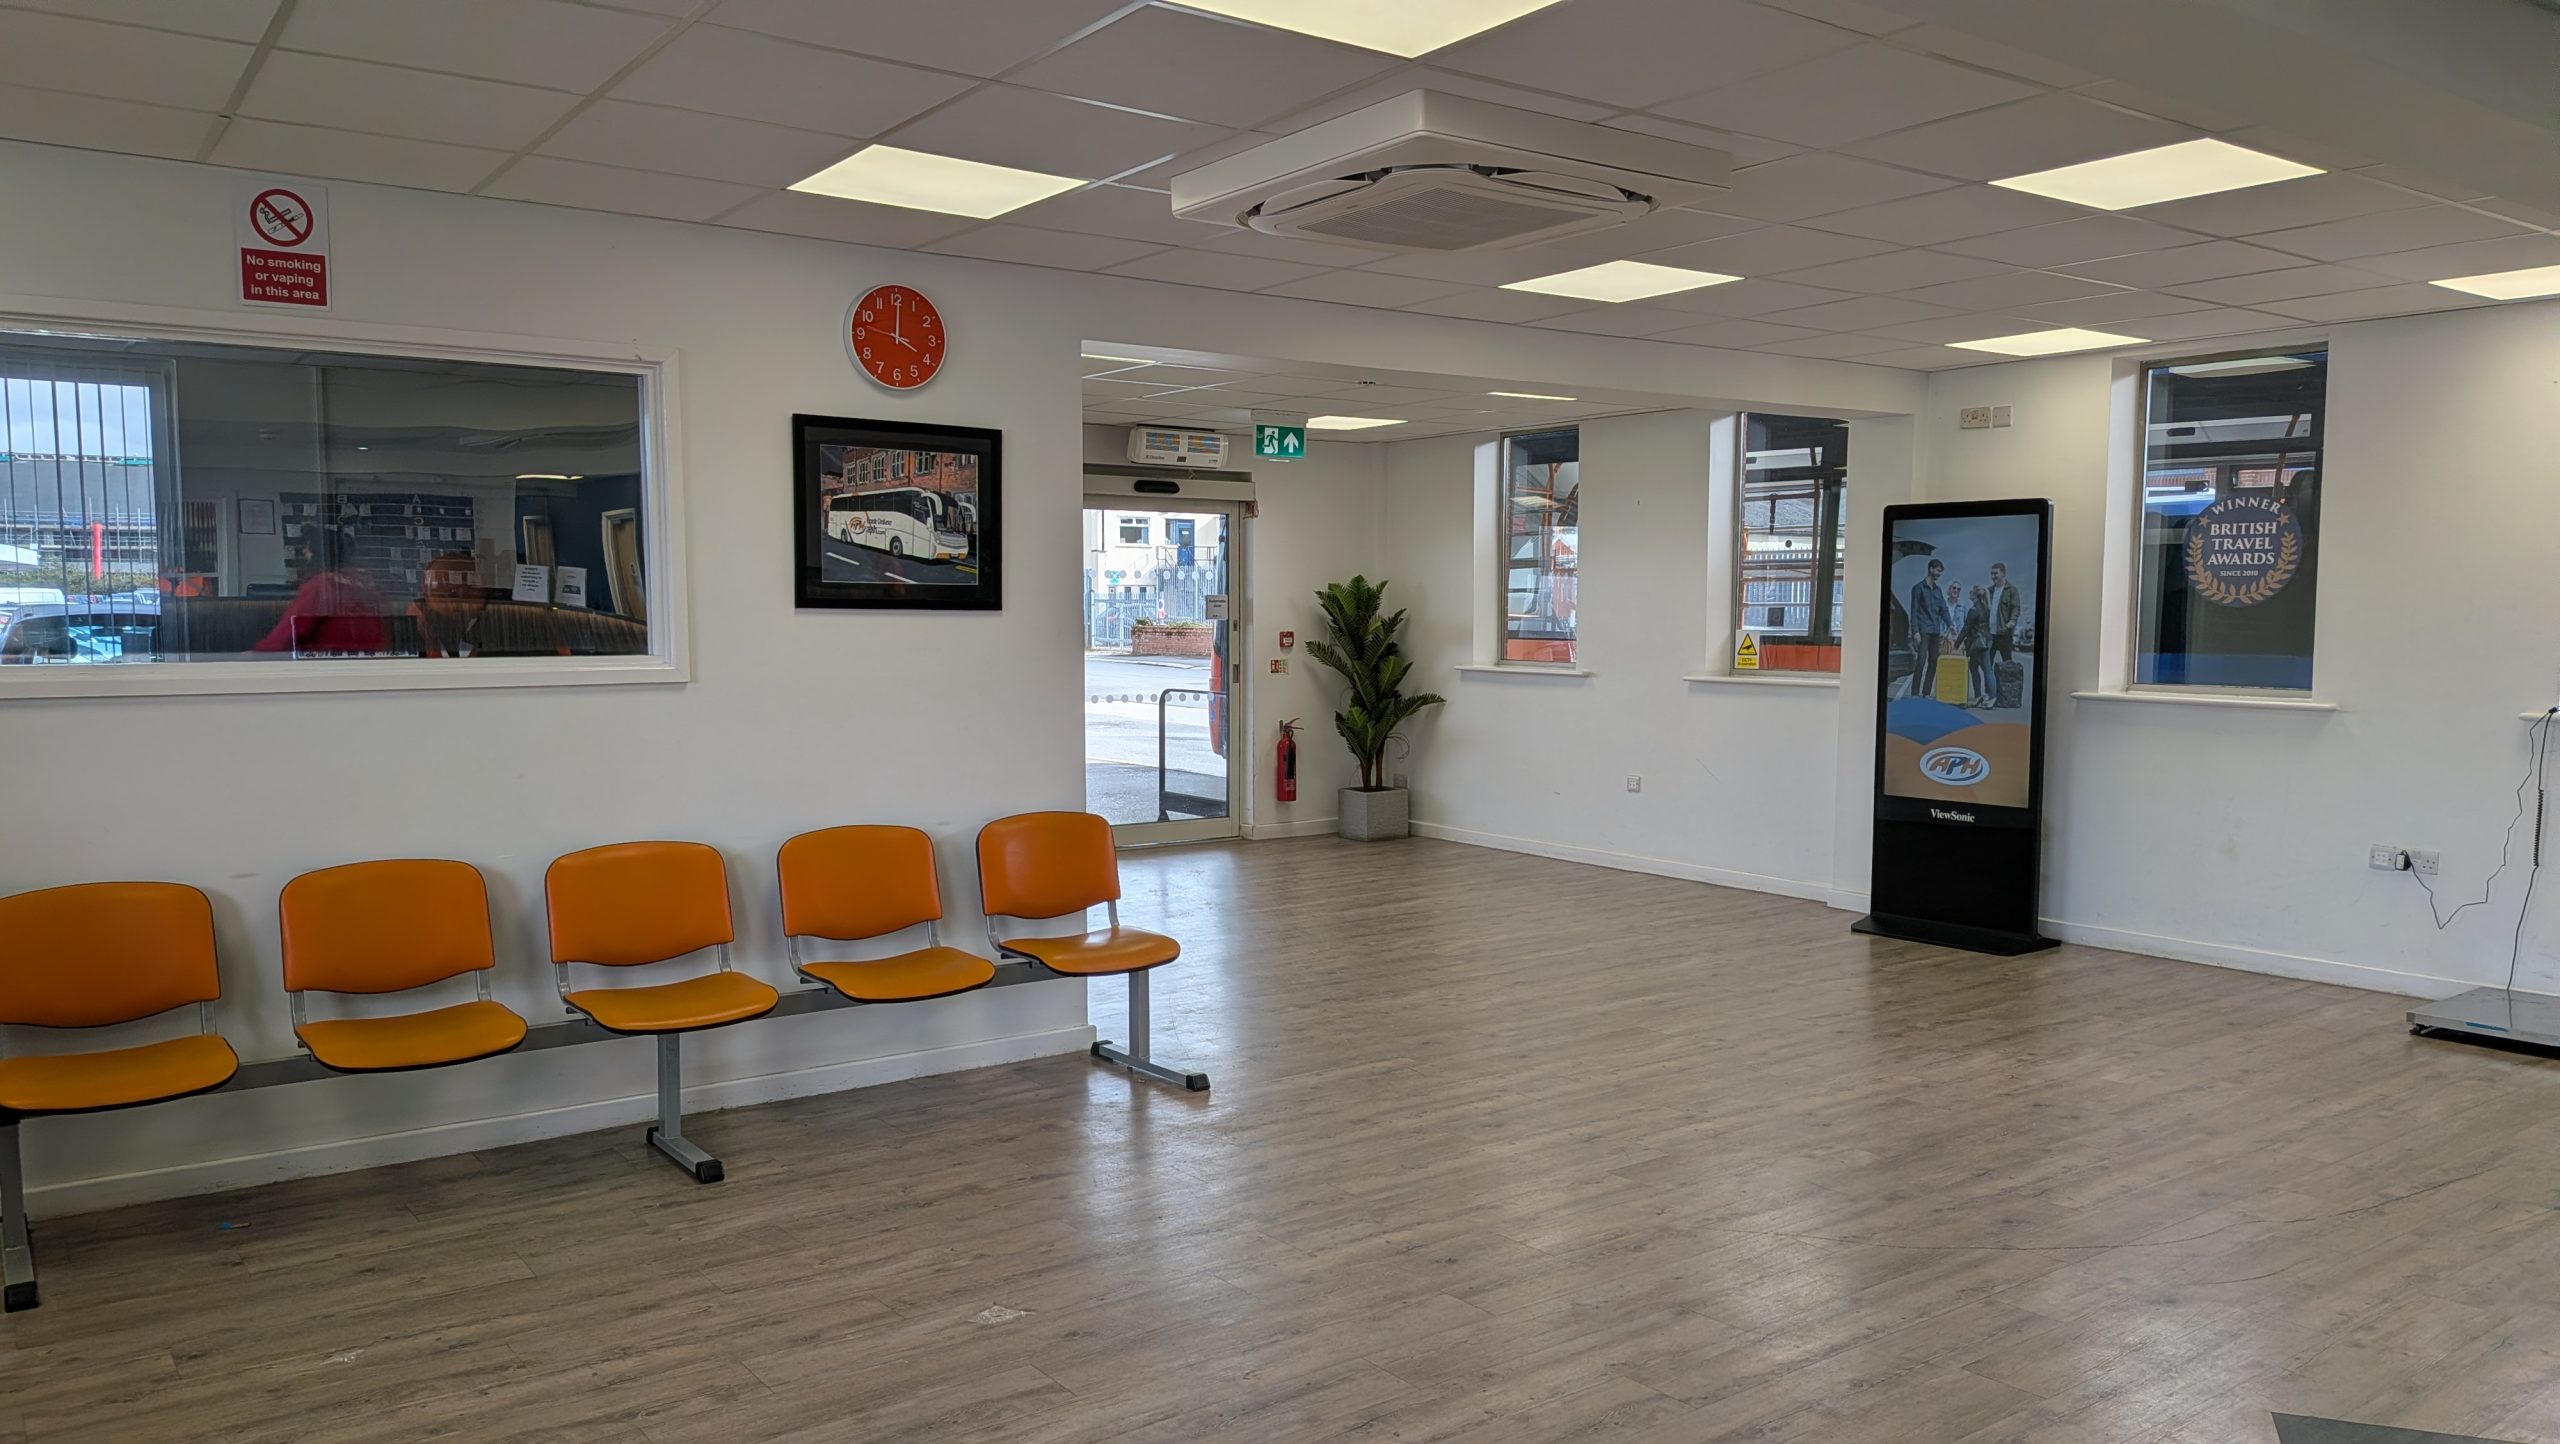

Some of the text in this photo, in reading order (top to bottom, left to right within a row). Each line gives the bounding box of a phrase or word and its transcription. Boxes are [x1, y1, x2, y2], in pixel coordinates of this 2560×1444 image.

[246, 254, 321, 273] No smoking
[255, 272, 314, 287] or vaping
[250, 284, 319, 300] in this area
[876, 297, 883, 310] 11
[890, 293, 902, 306] 12
[911, 300, 916, 312] 1
[862, 309, 874, 322] 10
[922, 315, 931, 327] 2
[856, 327, 865, 340] 9
[928, 335, 936, 347] 3
[862, 347, 872, 360] 8
[922, 353, 931, 366] 4
[876, 361, 885, 374] 7
[910, 365, 919, 377] 5
[893, 368, 901, 381] 6
[2211, 496, 2281, 515] WINNER
[2210, 522, 2277, 536] BRITISH
[2211, 537, 2274, 550] TRAVEL
[2206, 552, 2275, 565] AWARDS
[1929, 756, 1982, 776] APH
[1930, 808, 1975, 823] ViewSonic
